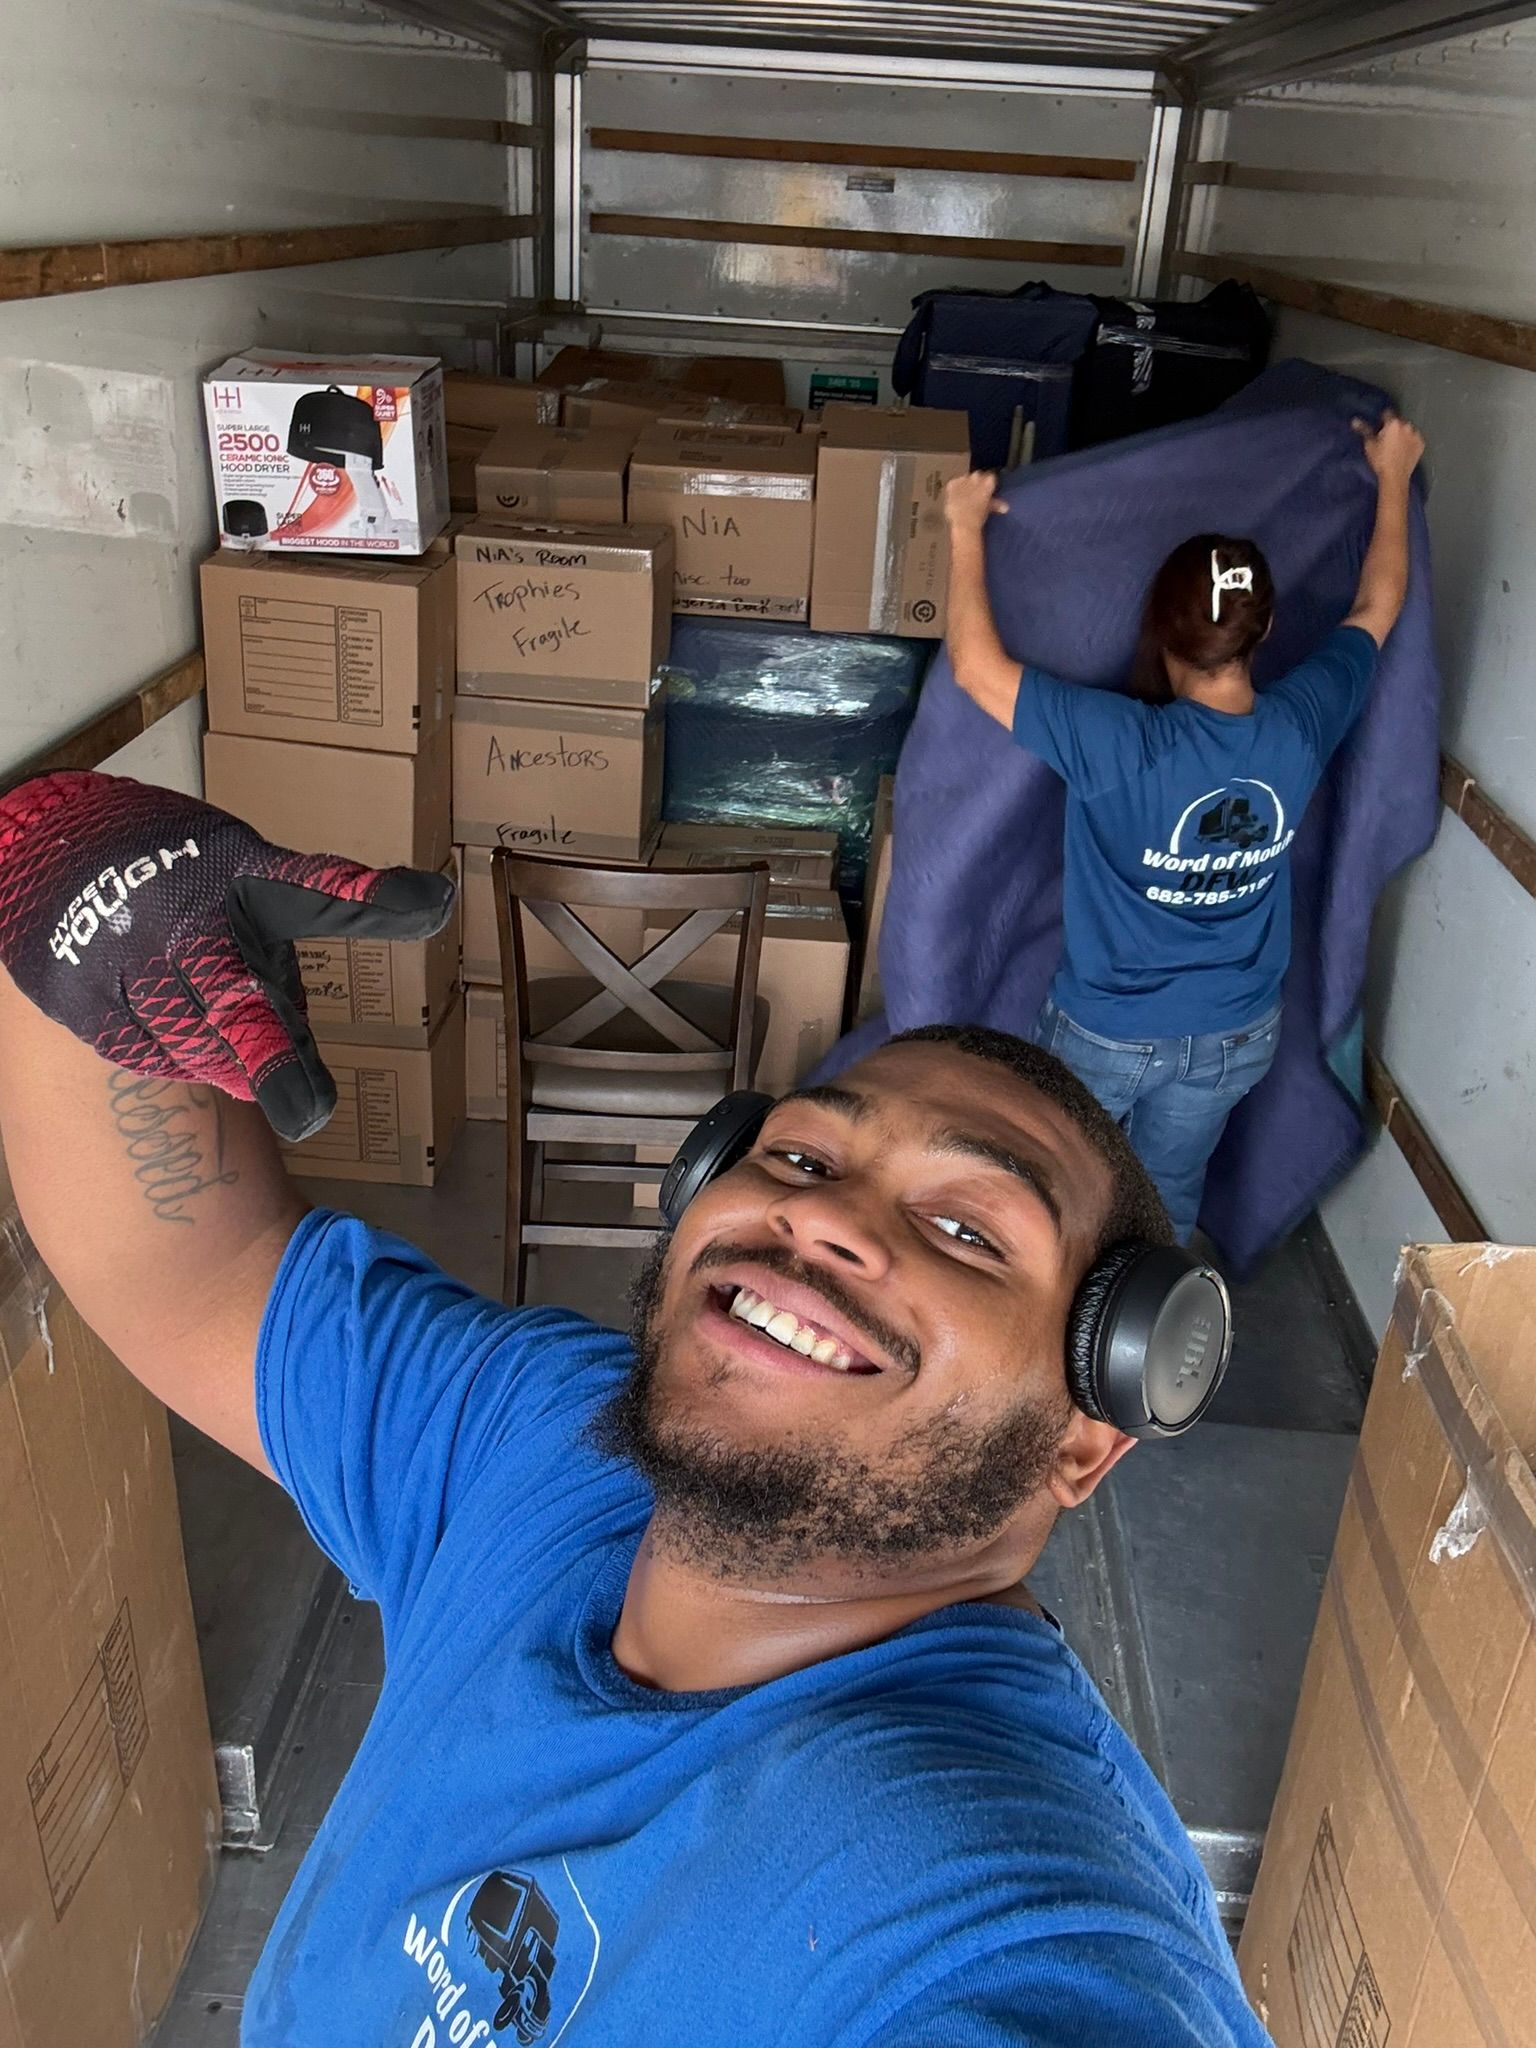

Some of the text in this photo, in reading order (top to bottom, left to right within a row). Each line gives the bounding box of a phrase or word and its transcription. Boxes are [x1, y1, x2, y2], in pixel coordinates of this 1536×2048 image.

[217, 424, 270, 432] SUPER LARGE
[218, 433, 280, 452] 2500
[220, 453, 290, 463] CERAMIC IONIC
[220, 463, 290, 473] HOOD DRYER
[281, 537, 315, 546] BIGGEST
[316, 538, 340, 547] HOOD
[350, 539, 366, 548] THE
[366, 540, 396, 549] WORLD
[512, 617, 591, 657] Fragile
[496, 814, 577, 846] Fragile
[1142, 848, 1211, 873] Word
[1212, 850, 1244, 871] of
[1178, 866, 1261, 893] DFW
[49, 866, 118, 953] HYPER
[55, 838, 200, 966] TOUGH
[403, 1912, 467, 2022] Word
